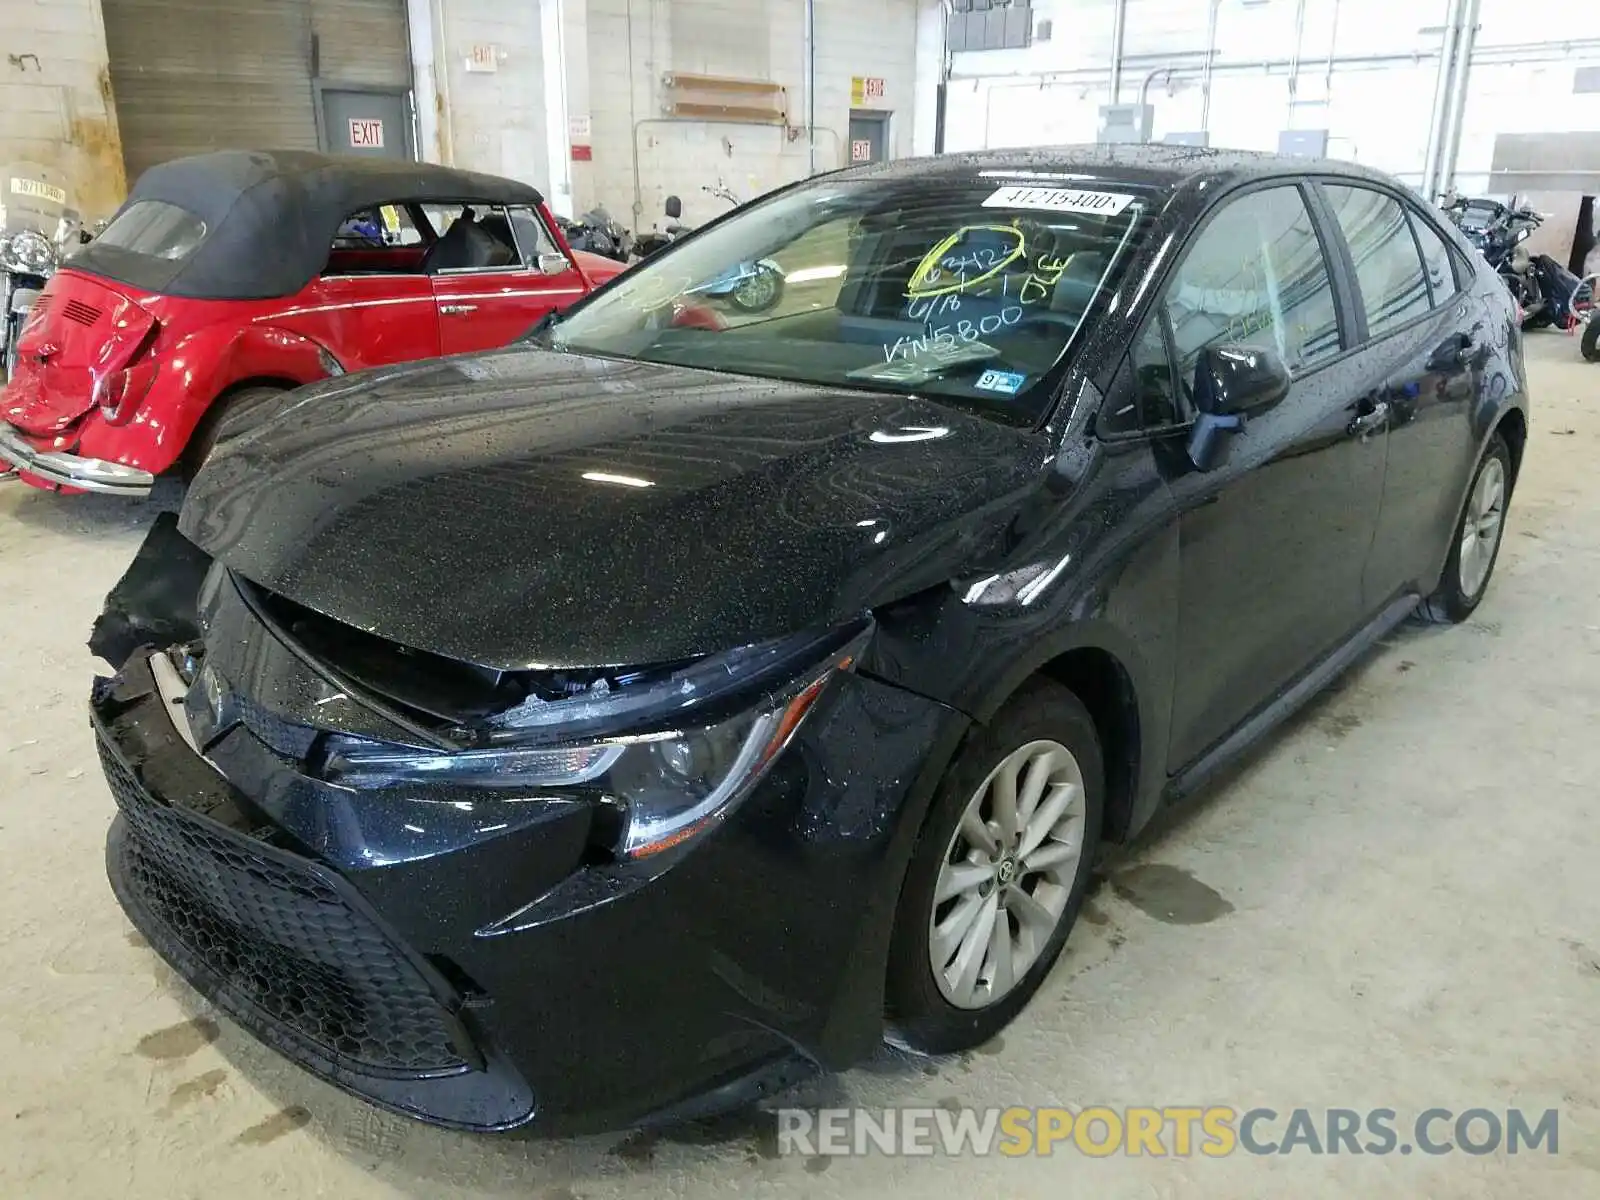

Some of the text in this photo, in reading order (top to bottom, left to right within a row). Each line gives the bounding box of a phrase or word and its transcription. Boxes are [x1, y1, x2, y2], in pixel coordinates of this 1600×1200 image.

[473, 45, 491, 65] EXIT
[866, 78, 885, 97] EXIT
[352, 122, 380, 144] EXIT
[854, 142, 869, 159] EXIT
[982, 374, 995, 385] 9
